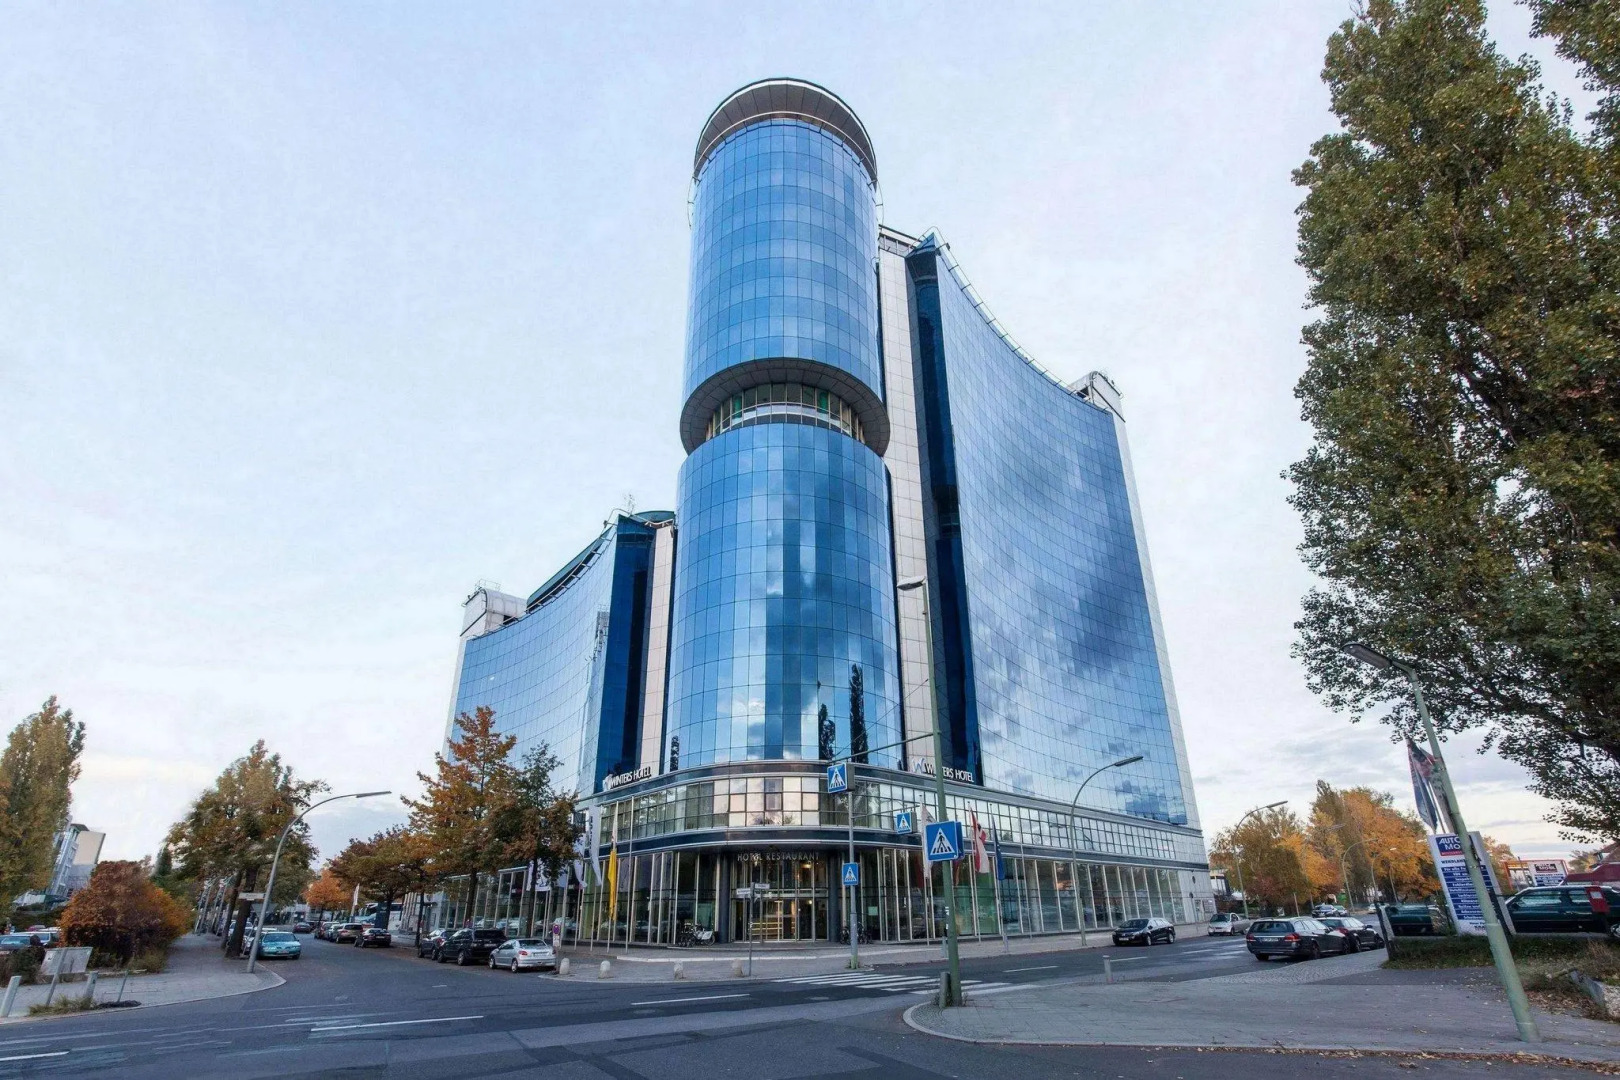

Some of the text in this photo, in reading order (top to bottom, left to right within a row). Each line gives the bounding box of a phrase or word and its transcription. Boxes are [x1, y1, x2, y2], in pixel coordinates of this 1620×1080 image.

[610, 771, 633, 788] WINTERS
[633, 766, 651, 780] HOTEL
[924, 763, 953, 778] WTERS
[954, 769, 974, 782] HOTEL
[1438, 836, 1461, 845] AUTO
[737, 852, 819, 861] HOTEL RESTAURANT
